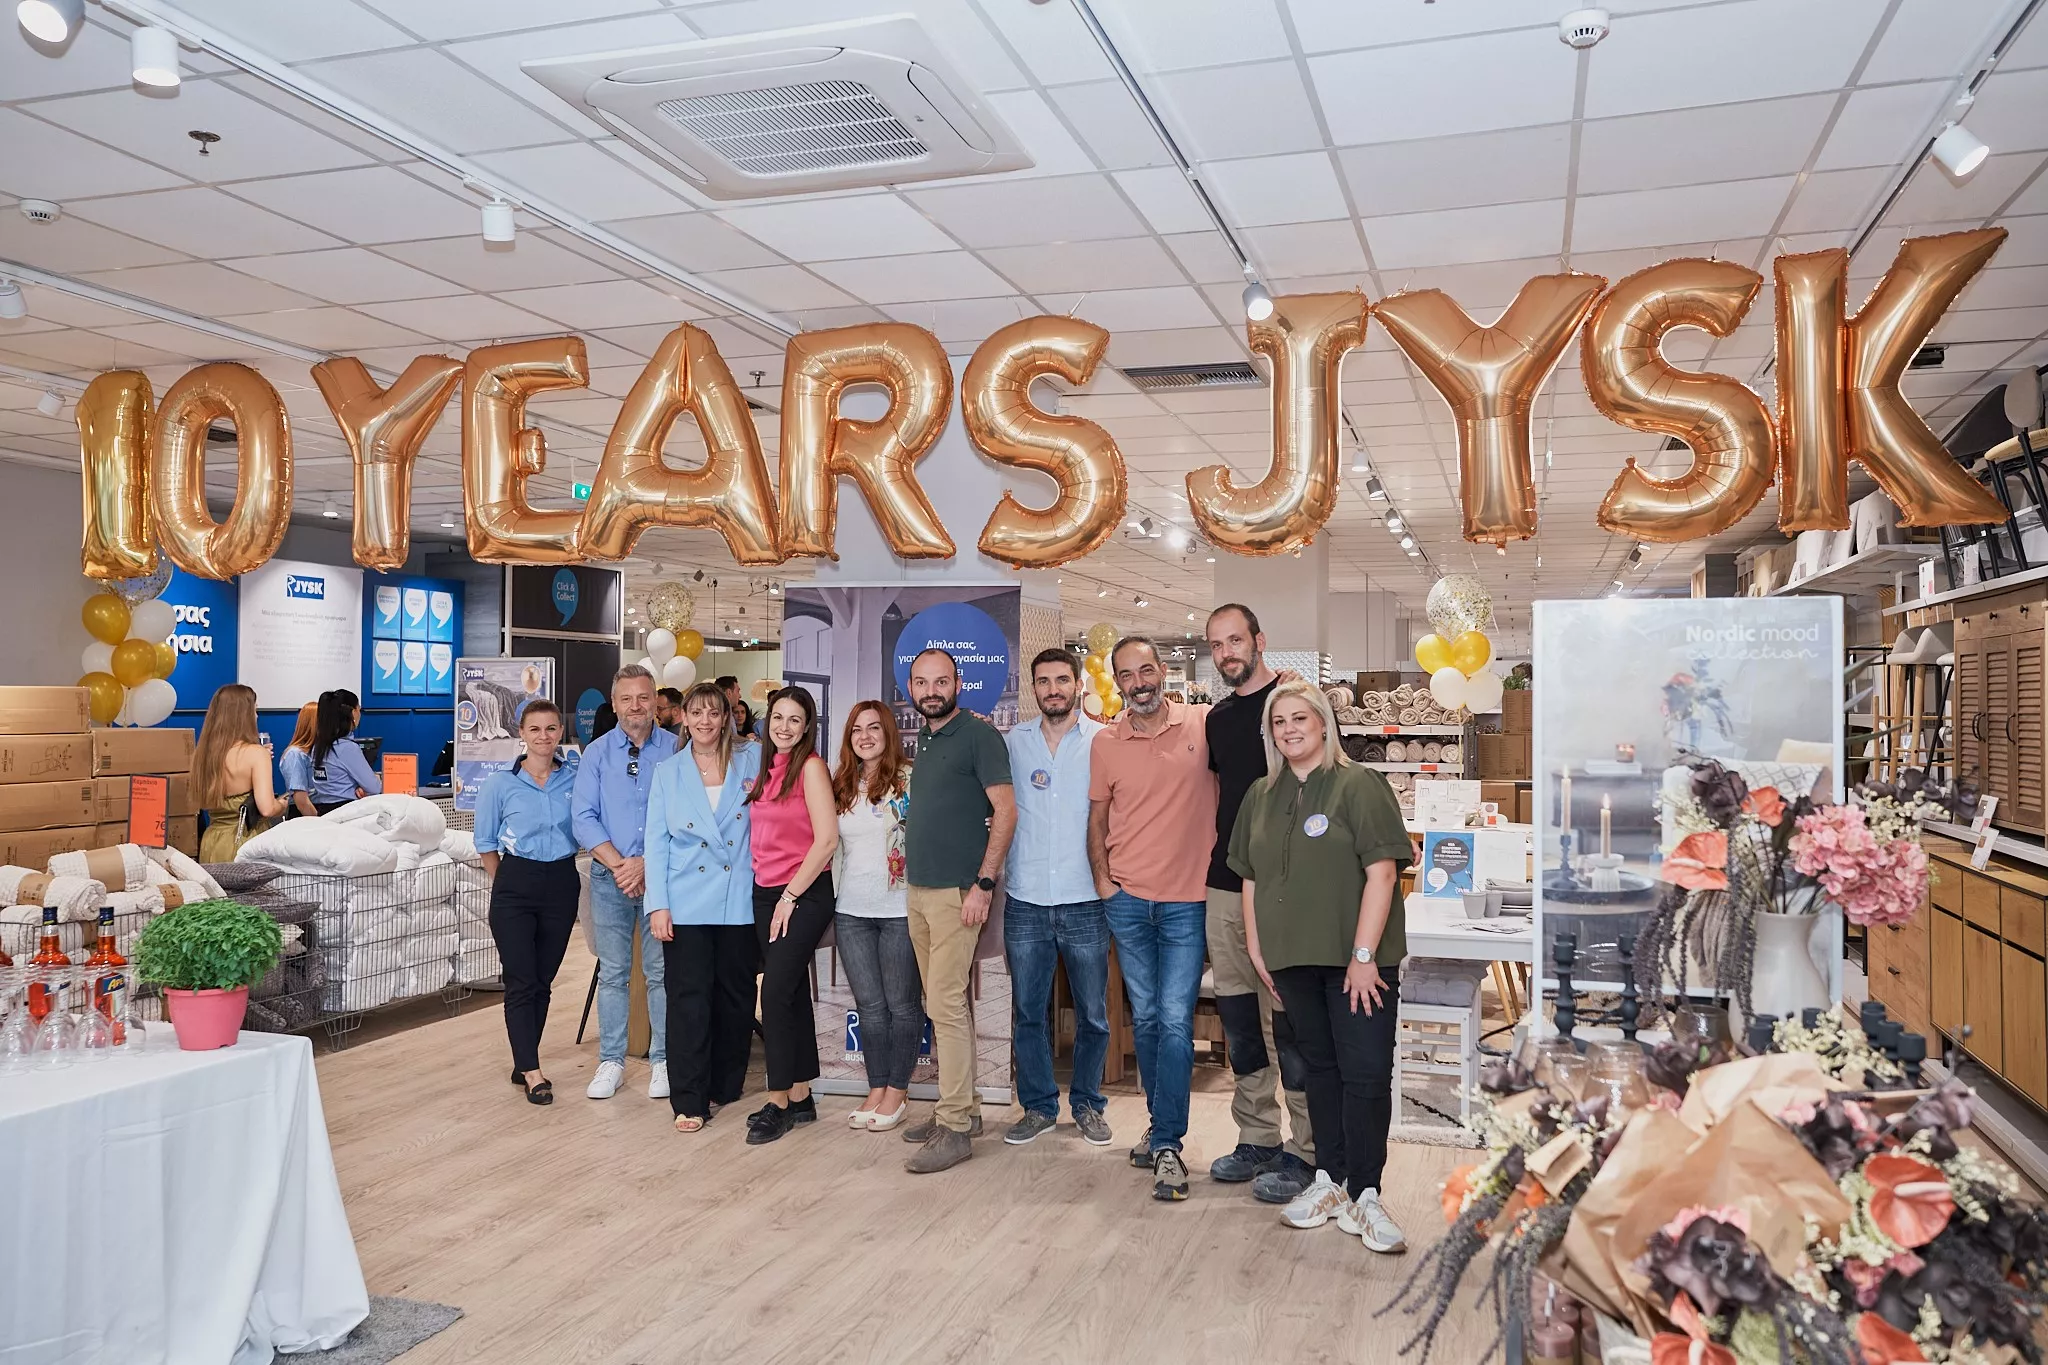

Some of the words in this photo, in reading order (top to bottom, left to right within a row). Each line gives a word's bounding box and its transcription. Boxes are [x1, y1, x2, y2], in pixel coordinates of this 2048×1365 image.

[75, 361, 294, 581] 10
[310, 314, 1128, 571] YEARS
[1185, 227, 2007, 557] JYSK
[294, 580, 323, 595] JYSK
[556, 582, 569, 592] Click
[570, 583, 575, 592] &
[556, 591, 575, 601] Collect
[1685, 623, 1756, 643] Nordic
[1761, 623, 1820, 642] mood
[165, 627, 213, 656] ήσια
[926, 639, 954, 649] Δίπλα
[956, 641, 977, 650] σας,
[987, 655, 1005, 664] μας
[466, 669, 484, 679] JYSK
[577, 708, 596, 716] Scandin
